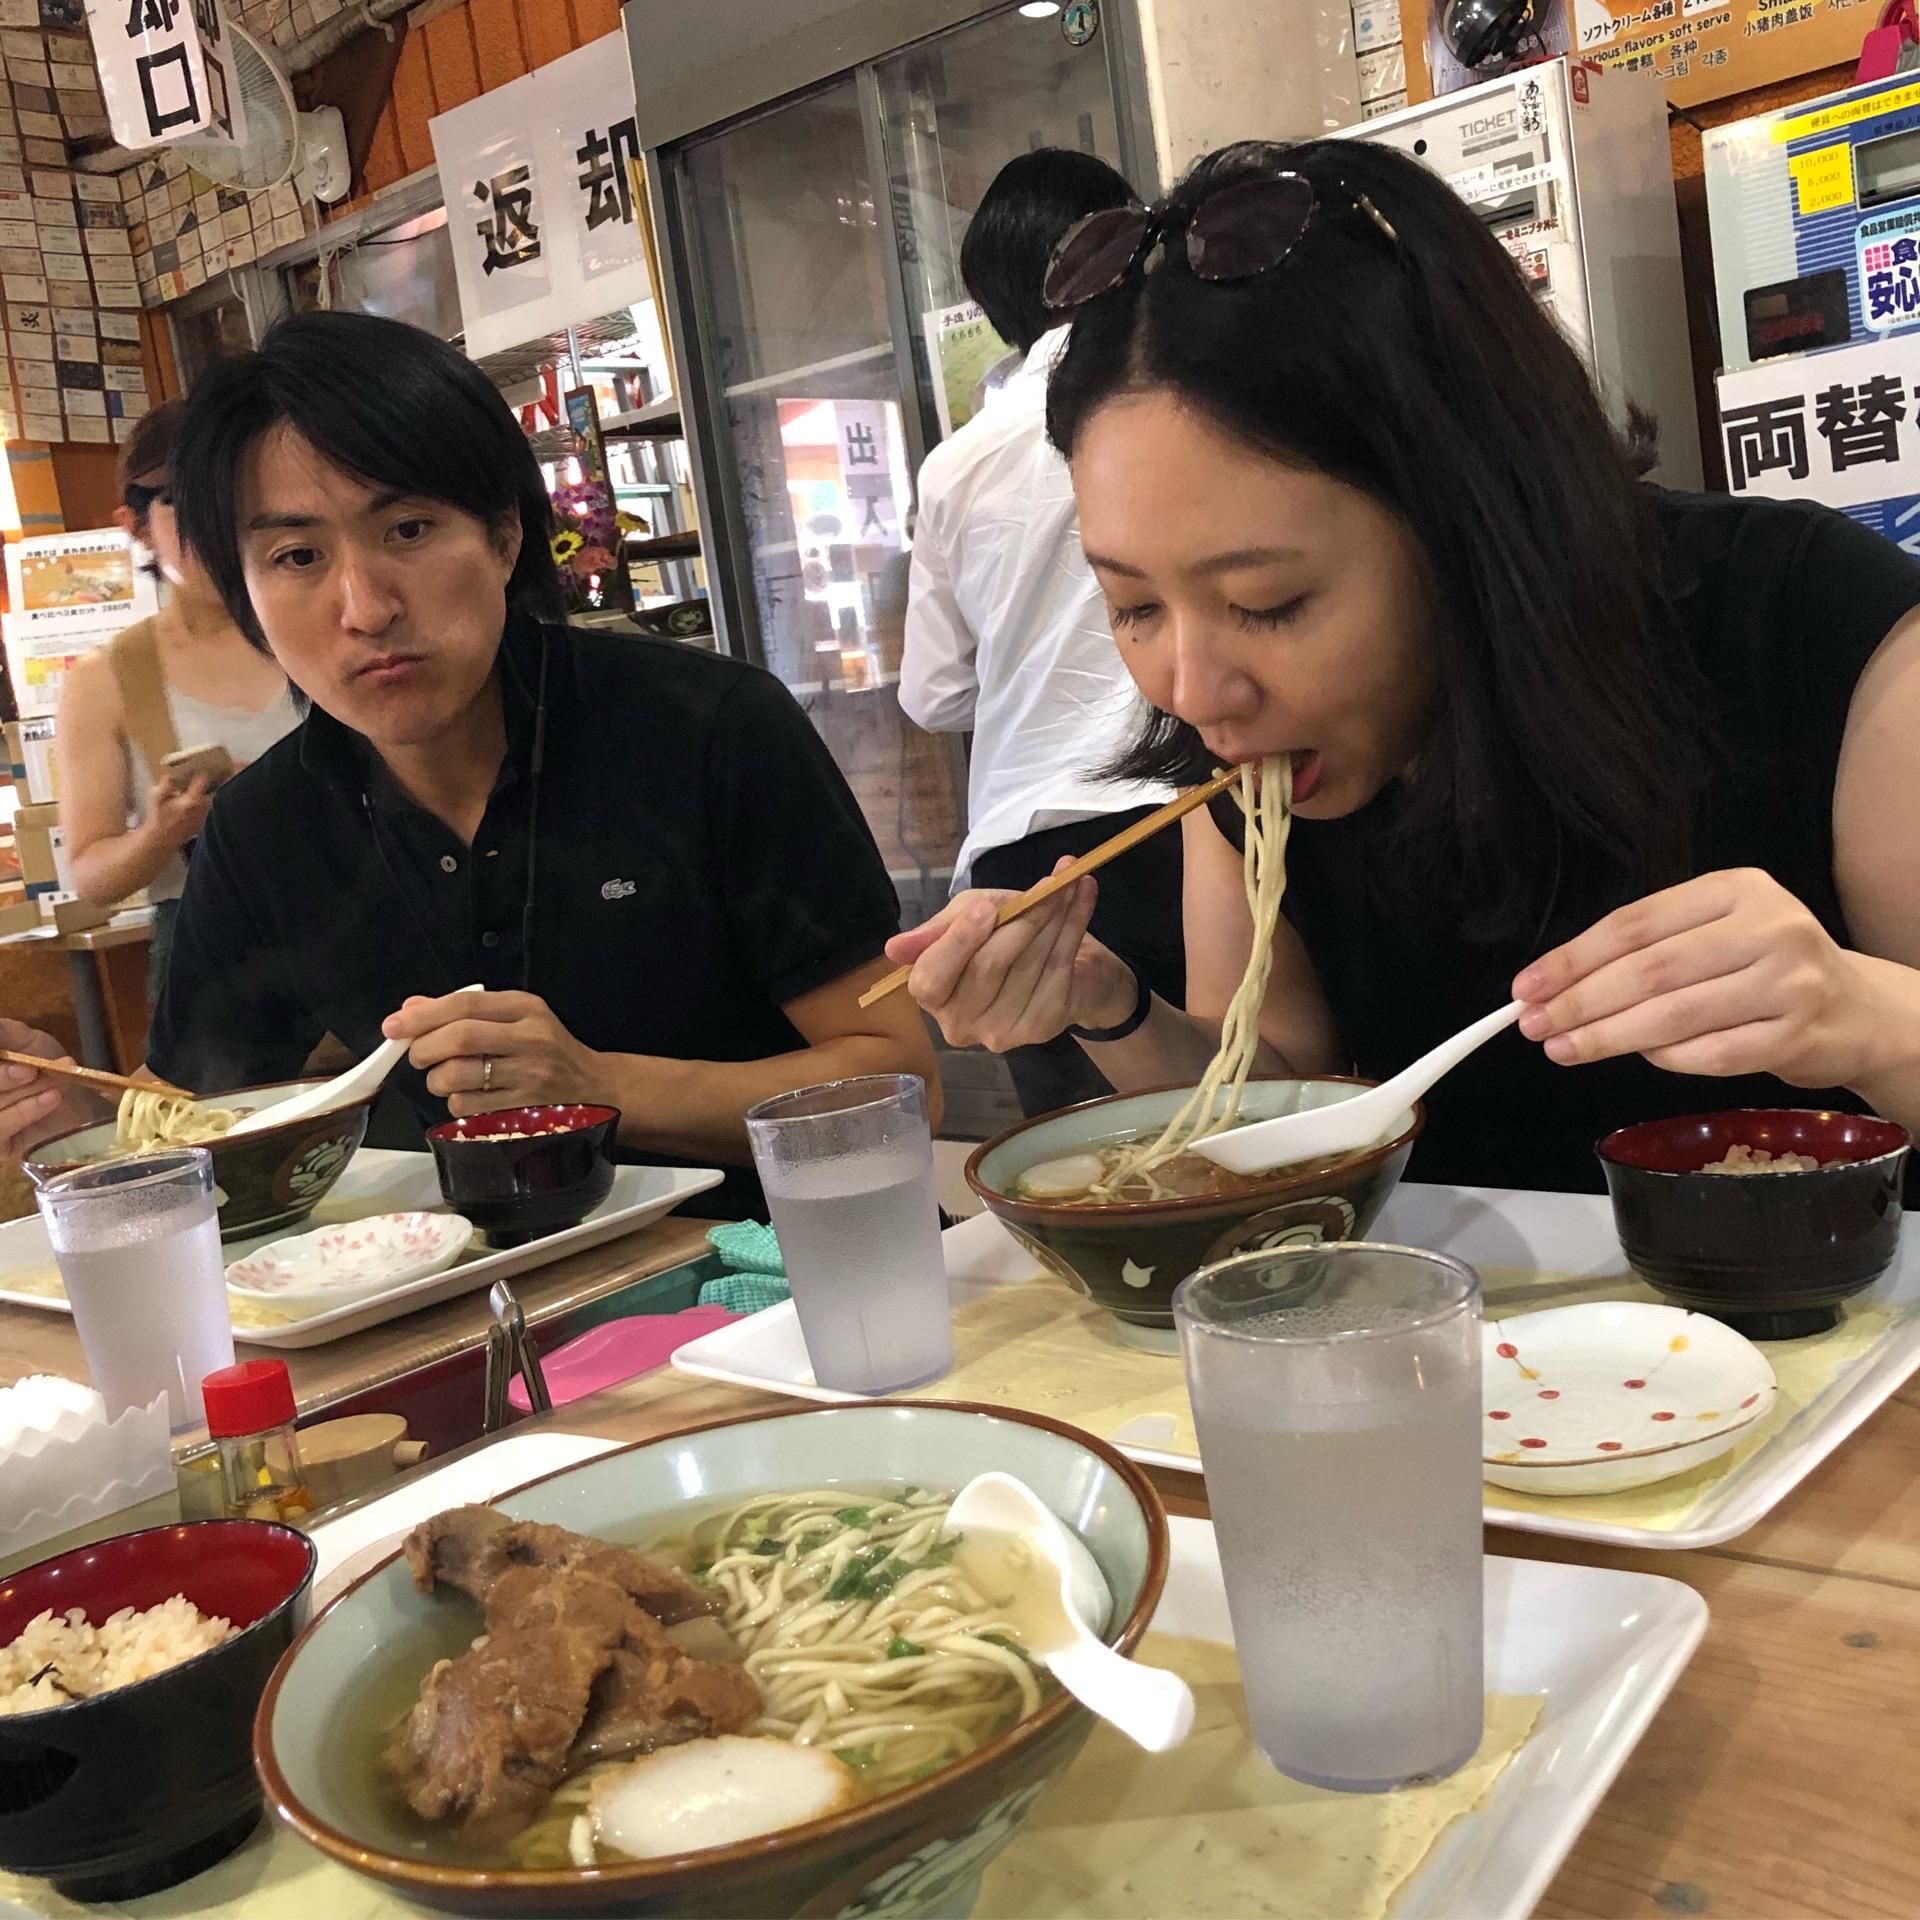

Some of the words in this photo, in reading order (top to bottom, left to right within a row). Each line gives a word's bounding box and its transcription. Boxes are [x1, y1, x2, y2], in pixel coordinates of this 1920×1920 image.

[1583, 3, 1674, 42] ソフトクリーム各種
[1624, 34, 1665, 53] flavors
[1668, 21, 1692, 40] soft
[1696, 12, 1731, 31] serve
[1743, 3, 1813, 37] 小猪肉盖饭
[1669, 40, 1698, 59] 各种
[1458, 109, 1517, 138] TICKET
[1800, 151, 1839, 169] 10,000
[1807, 171, 1841, 187] 5,000
[473, 116, 642, 276] 返却
[1809, 191, 1843, 207] 2,000
[1890, 237, 1920, 266] 食
[1868, 266, 1920, 320] 安心
[1721, 374, 1920, 491] 両替
